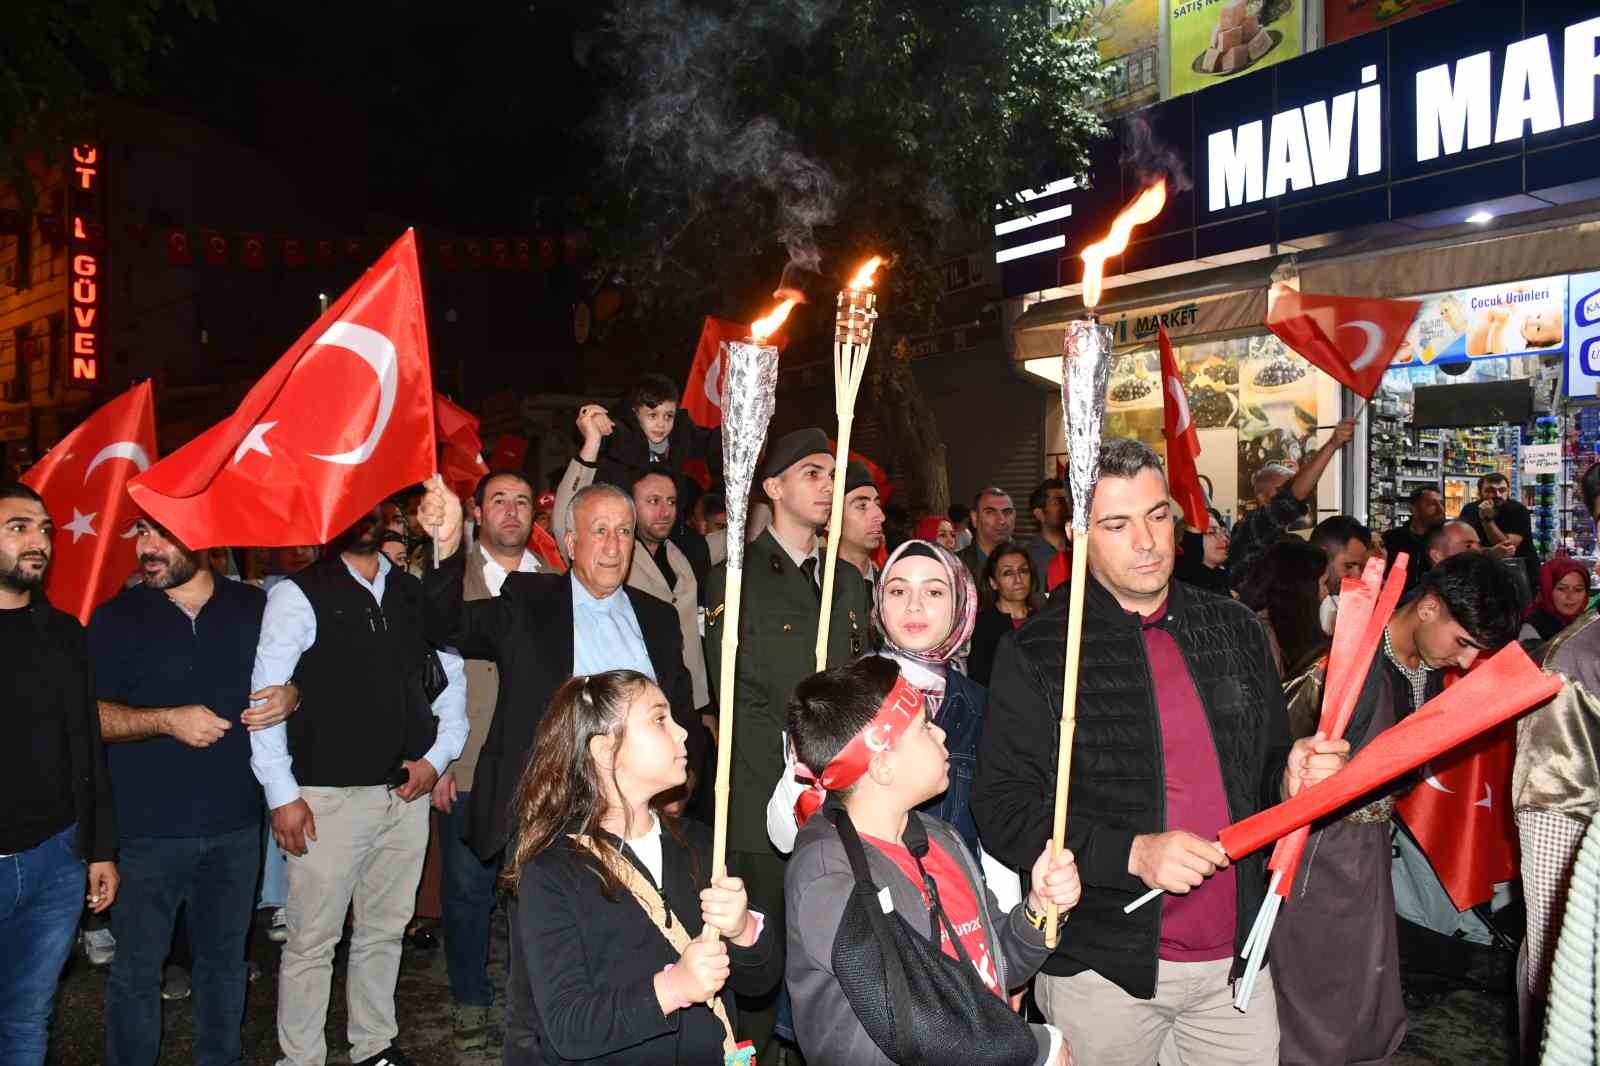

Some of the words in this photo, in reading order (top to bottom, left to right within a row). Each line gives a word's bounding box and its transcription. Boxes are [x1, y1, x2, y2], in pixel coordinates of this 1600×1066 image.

[1173, 1, 1203, 19] SATIŞ
[1208, 65, 1382, 213] MAVİ
[1471, 293, 1503, 312] Çocuk
[73, 255, 97, 379] GÜVEN
[1136, 308, 1199, 333] MARKET
